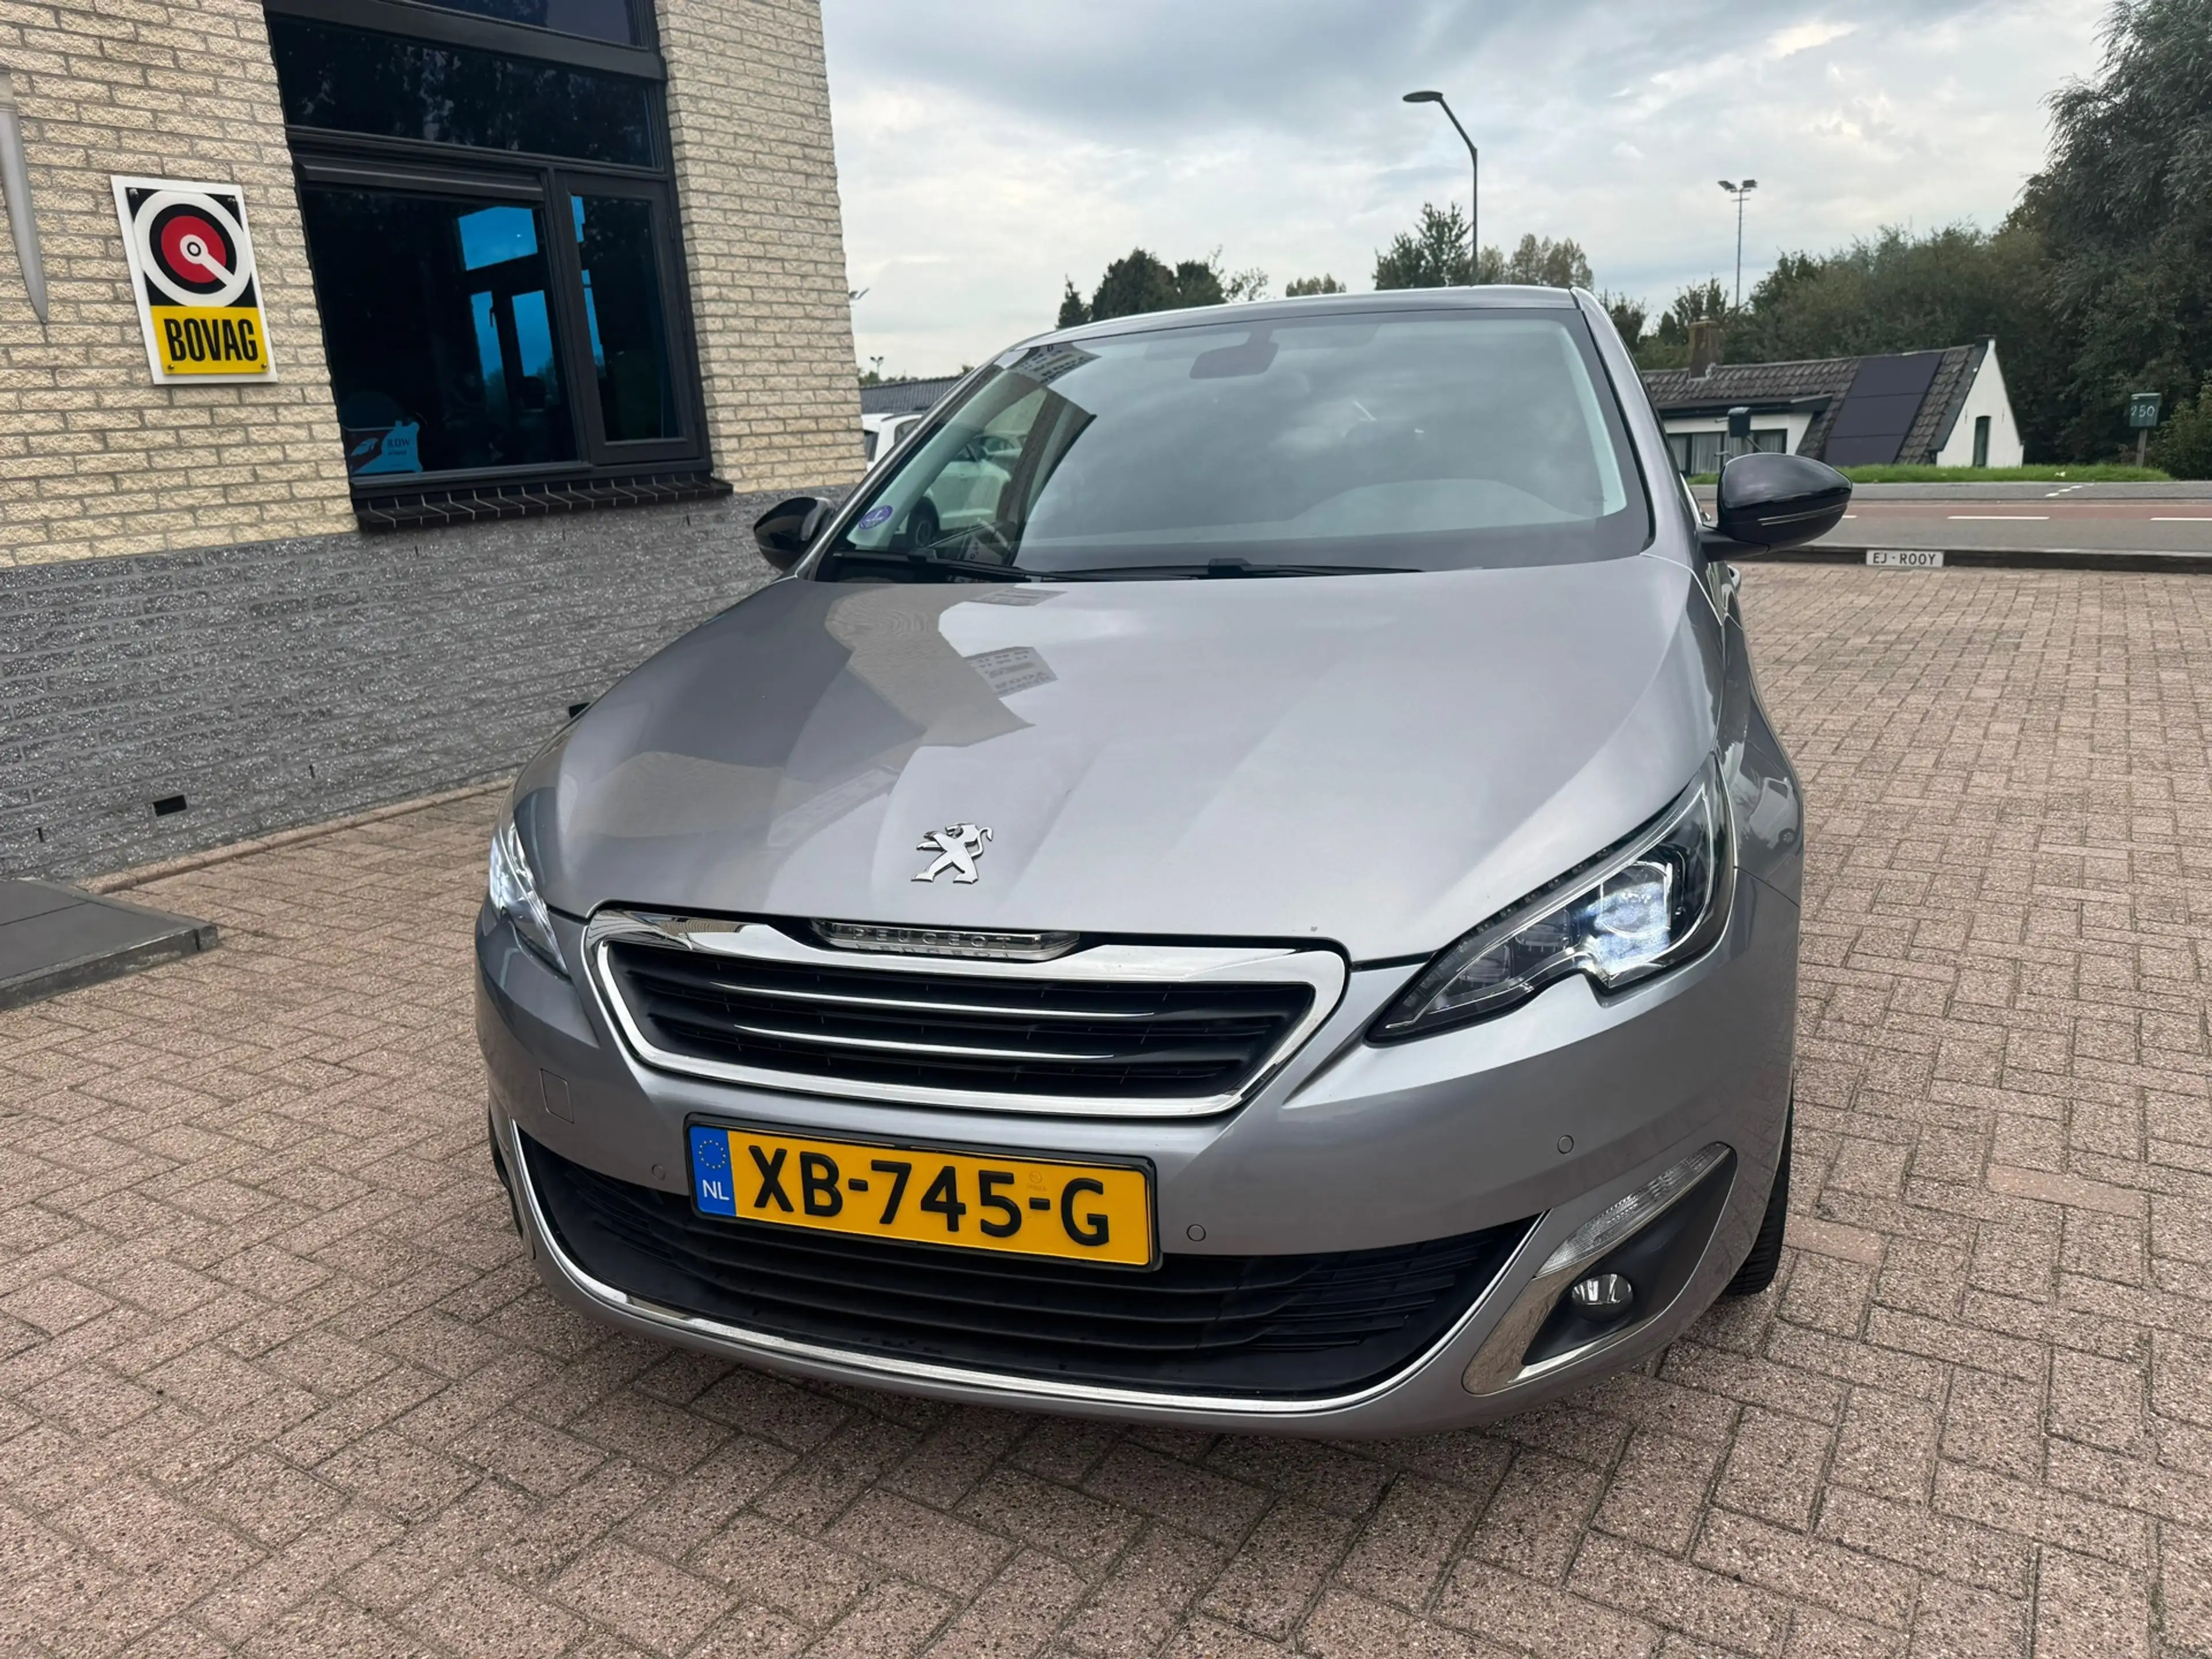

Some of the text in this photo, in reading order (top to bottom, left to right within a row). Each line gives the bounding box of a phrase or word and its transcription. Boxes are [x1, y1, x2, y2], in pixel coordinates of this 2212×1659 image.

[164, 318, 258, 362] BOVAG
[2130, 405, 2156, 418] 250
[387, 438, 411, 448] RDW
[1873, 552, 1887, 564] EJ
[1899, 552, 1936, 565] ROOY
[702, 1180, 730, 1201] NL
[748, 1145, 1109, 1247] XB-745-G
